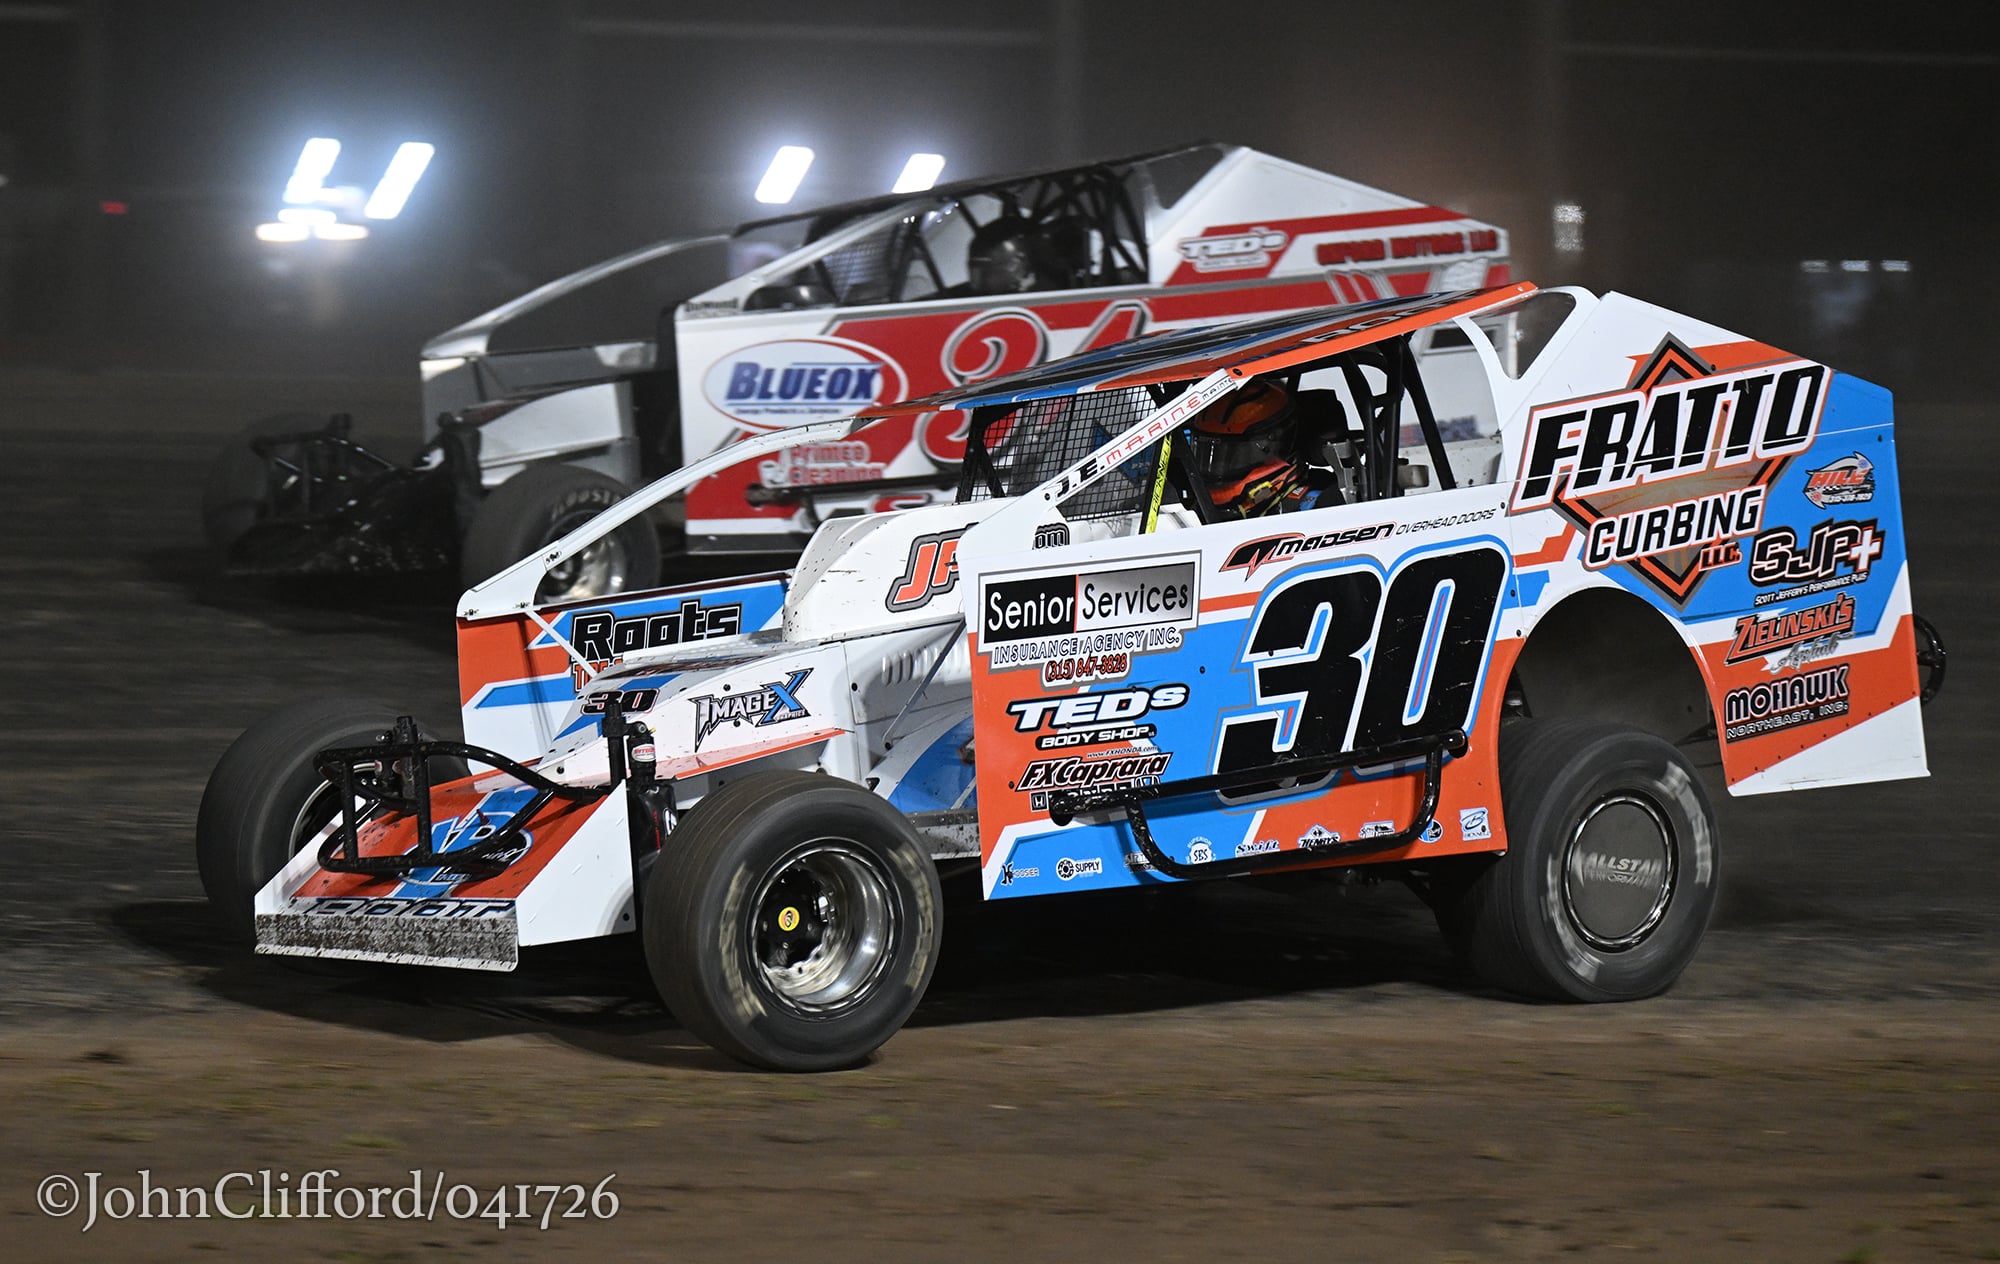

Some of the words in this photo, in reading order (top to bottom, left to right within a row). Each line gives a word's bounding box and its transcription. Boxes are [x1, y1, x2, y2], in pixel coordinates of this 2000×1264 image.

[726, 361, 881, 401] BLUEOX
[1056, 458, 1105, 498] J.E.
[1106, 396, 1200, 465] MARINE
[1521, 364, 1825, 501] FRATTO
[1396, 515, 1457, 537] OVERHEAD
[1457, 508, 1497, 527] DOORS
[1589, 488, 1763, 565] CURBING
[572, 601, 741, 660] Roots
[988, 591, 1074, 632] Senior
[1082, 582, 1189, 620] Services
[1727, 593, 1855, 661] ZIELINSKI'S
[993, 638, 1079, 664] INSURANCE
[1083, 630, 1145, 654] AGENCY
[1149, 626, 1180, 646] INC.
[1045, 657, 1076, 682] (315)
[1075, 653, 1128, 678] 847-3828
[1214, 547, 1506, 798] 30
[1727, 666, 1849, 724] MOHAWK
[1041, 733, 1095, 749] BODY
[1098, 726, 1149, 742] SHOP
[1726, 709, 1814, 739] NORTHEAST,
[1820, 701, 1848, 717] INC.
[1017, 753, 1173, 791] FXCaprara
